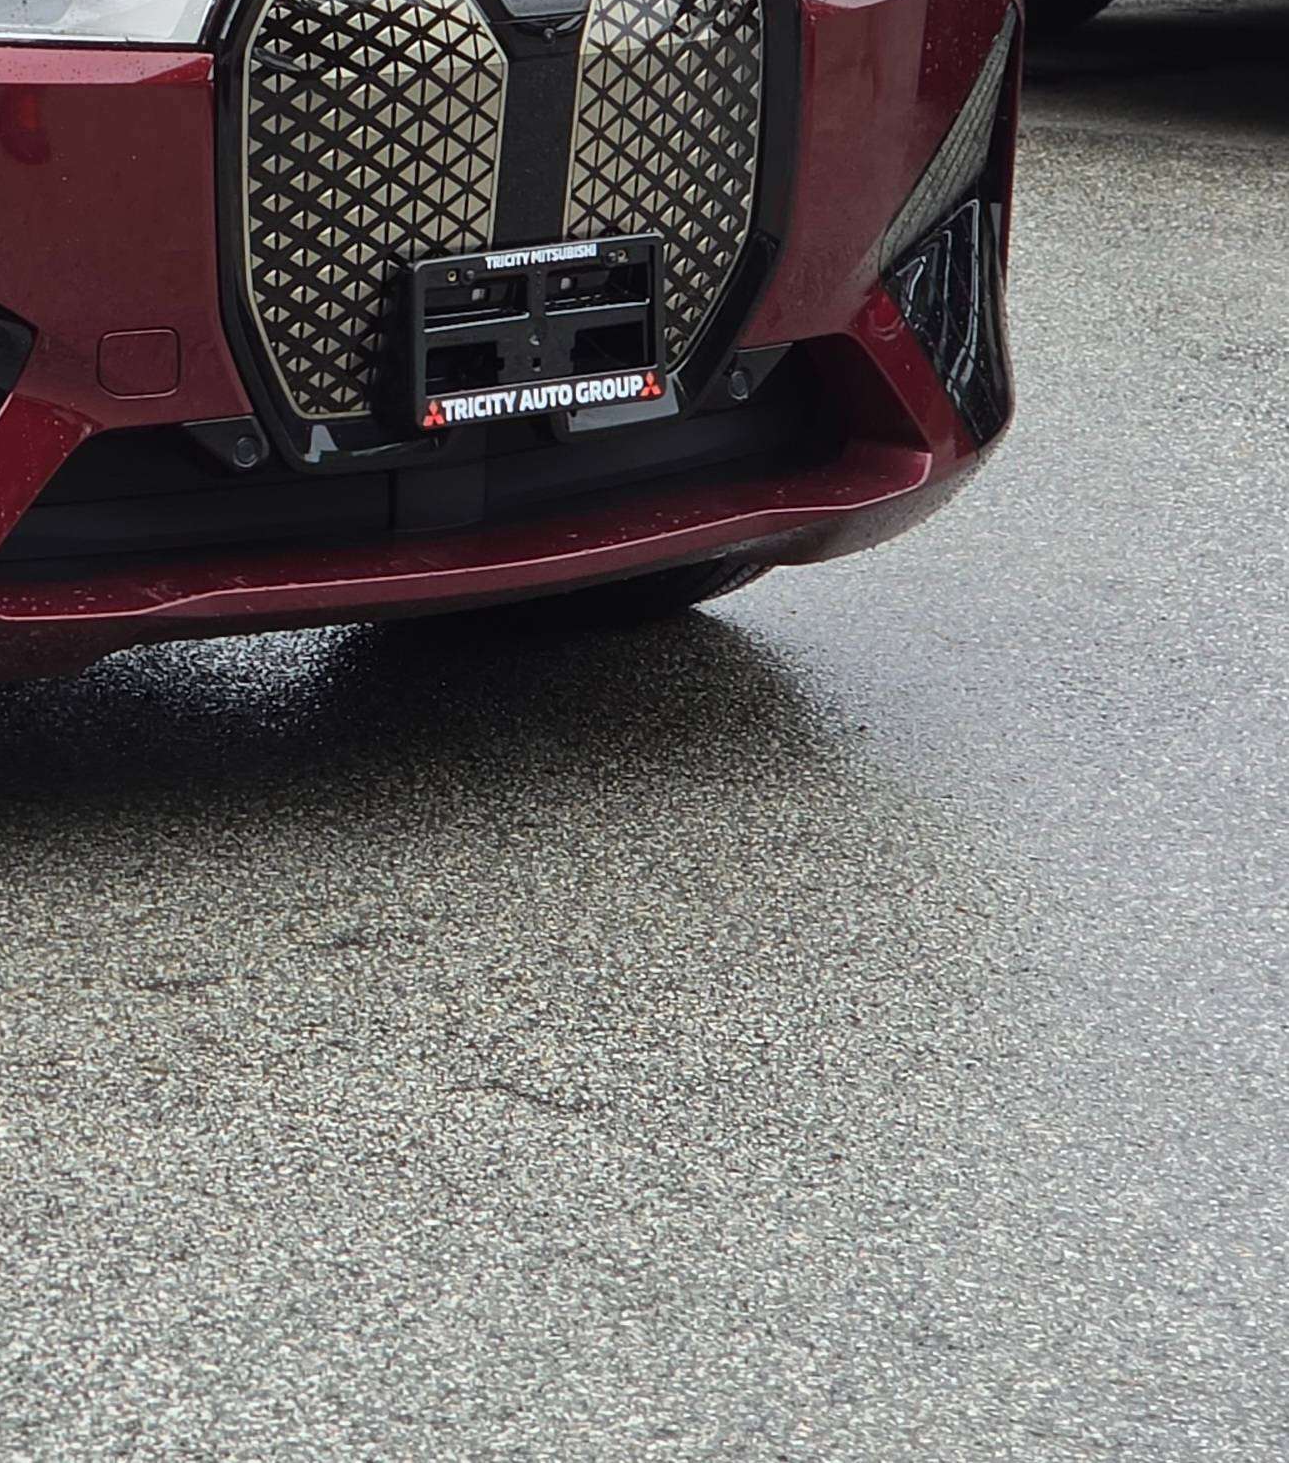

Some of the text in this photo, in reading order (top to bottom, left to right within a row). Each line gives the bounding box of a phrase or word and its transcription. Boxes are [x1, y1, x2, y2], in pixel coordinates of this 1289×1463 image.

[484, 243, 597, 270] TRICITY MITSUBISHI
[441, 374, 644, 422] TRICITY AUTO GROUP
